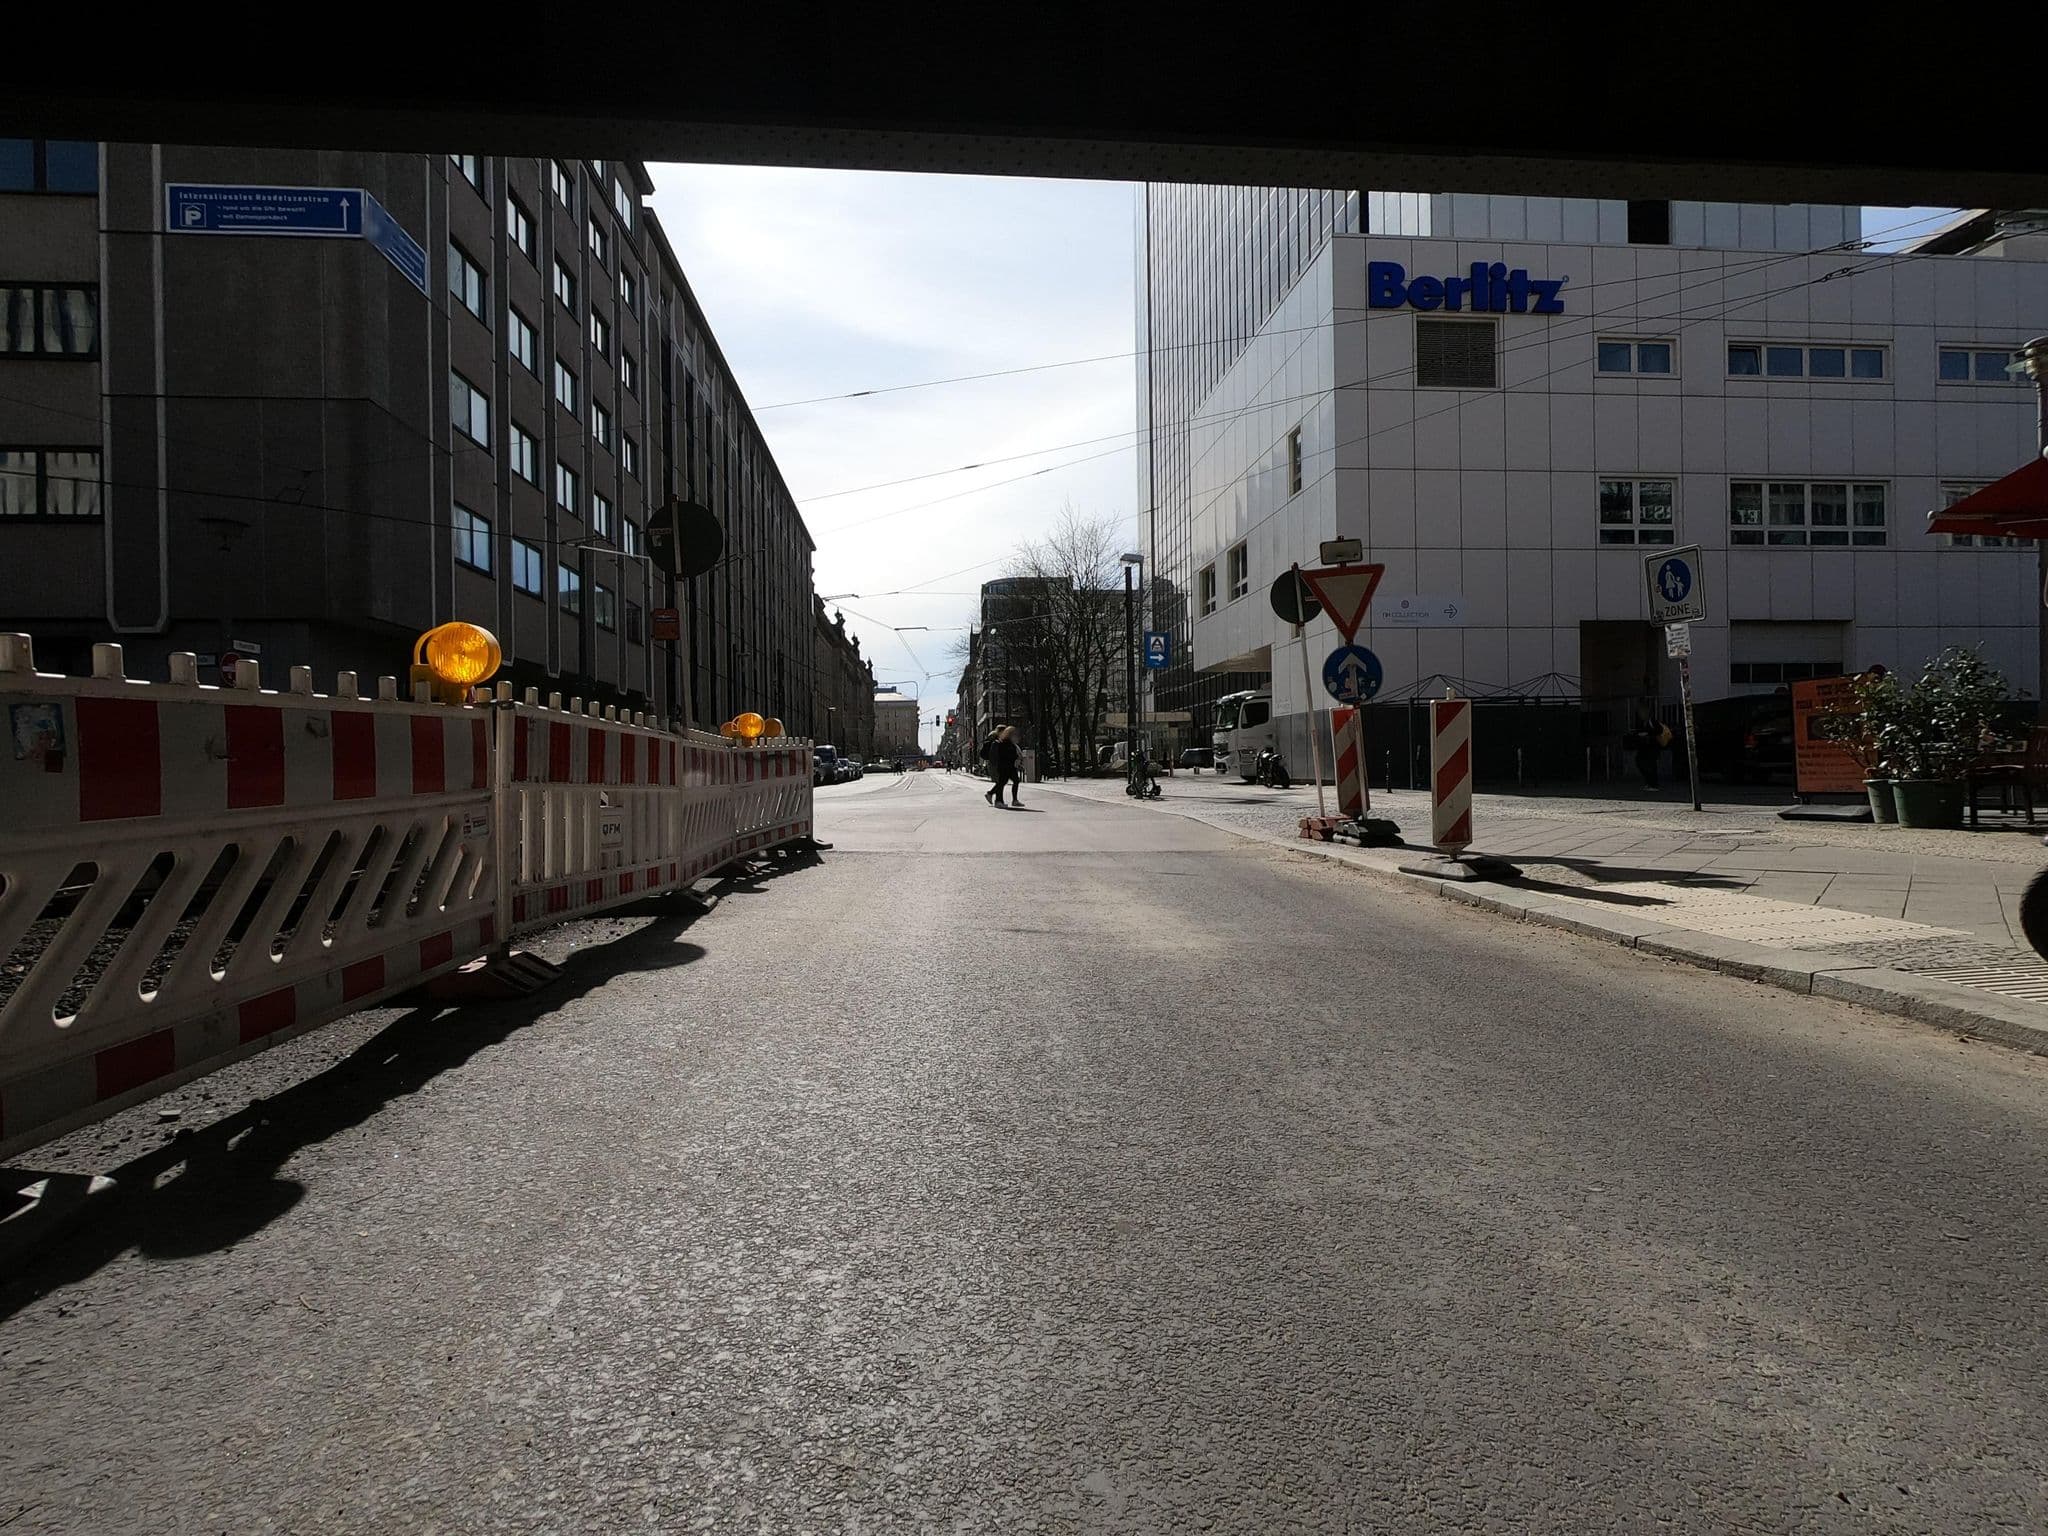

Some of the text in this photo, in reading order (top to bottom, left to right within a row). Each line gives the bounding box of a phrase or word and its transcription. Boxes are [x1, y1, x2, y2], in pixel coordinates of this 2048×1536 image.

[1368, 261, 1565, 313] Berlitz
[1664, 603, 1691, 617] ZONE
[602, 824, 621, 835] QFM
